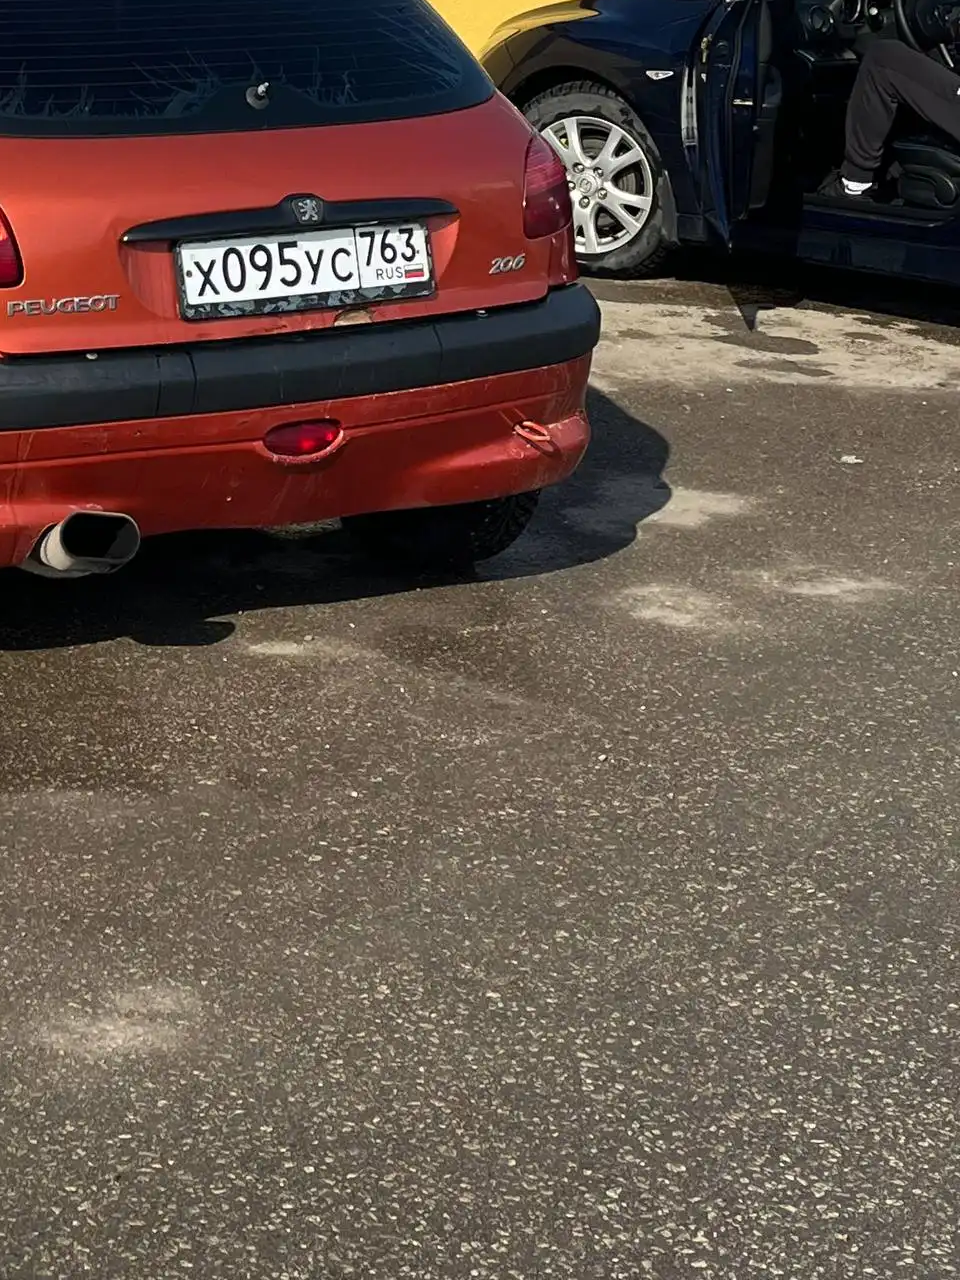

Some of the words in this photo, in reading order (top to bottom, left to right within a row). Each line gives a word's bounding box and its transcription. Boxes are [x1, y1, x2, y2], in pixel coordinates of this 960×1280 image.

[359, 228, 417, 266] 763
[376, 266, 404, 281] RUS
[489, 253, 526, 275] 206
[7, 294, 121, 317] PEUGEOT
